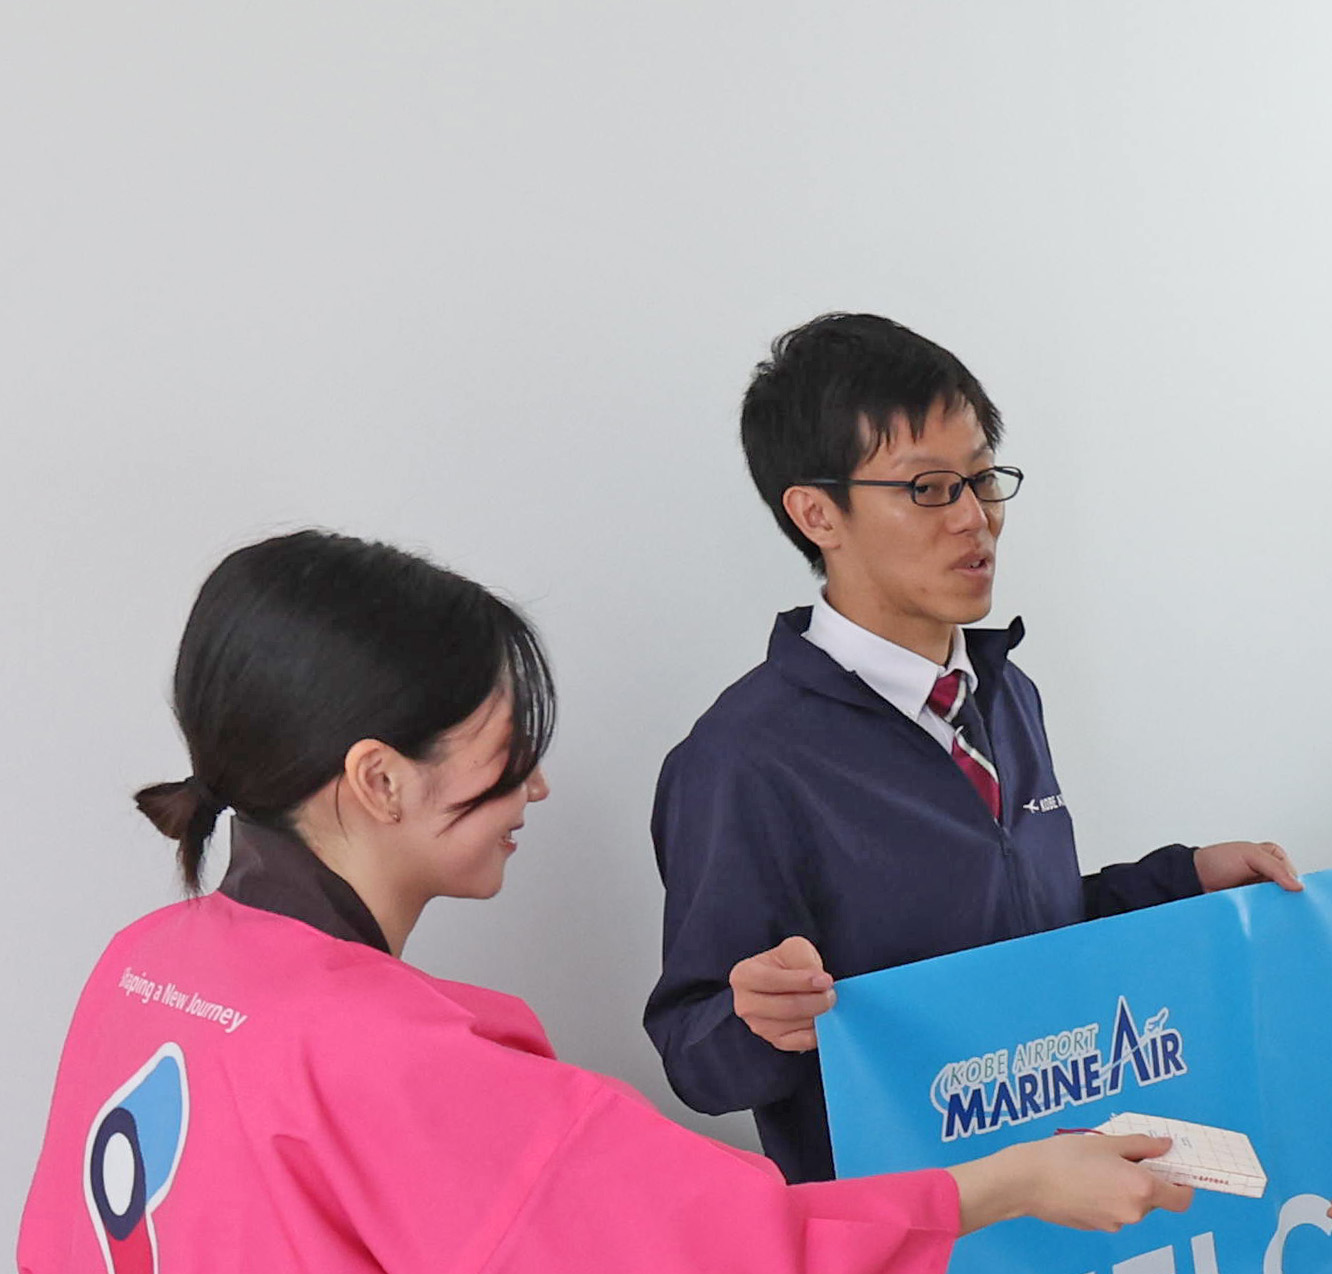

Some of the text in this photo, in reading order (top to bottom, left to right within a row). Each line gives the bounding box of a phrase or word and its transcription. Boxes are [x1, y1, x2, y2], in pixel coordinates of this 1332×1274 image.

[153, 985, 162, 1001] a
[161, 983, 189, 1010] New
[185, 993, 248, 1033] Journey
[945, 997, 1186, 1138] MARINE AIR
[947, 1027, 1098, 1087] KOBE AIRPORT
